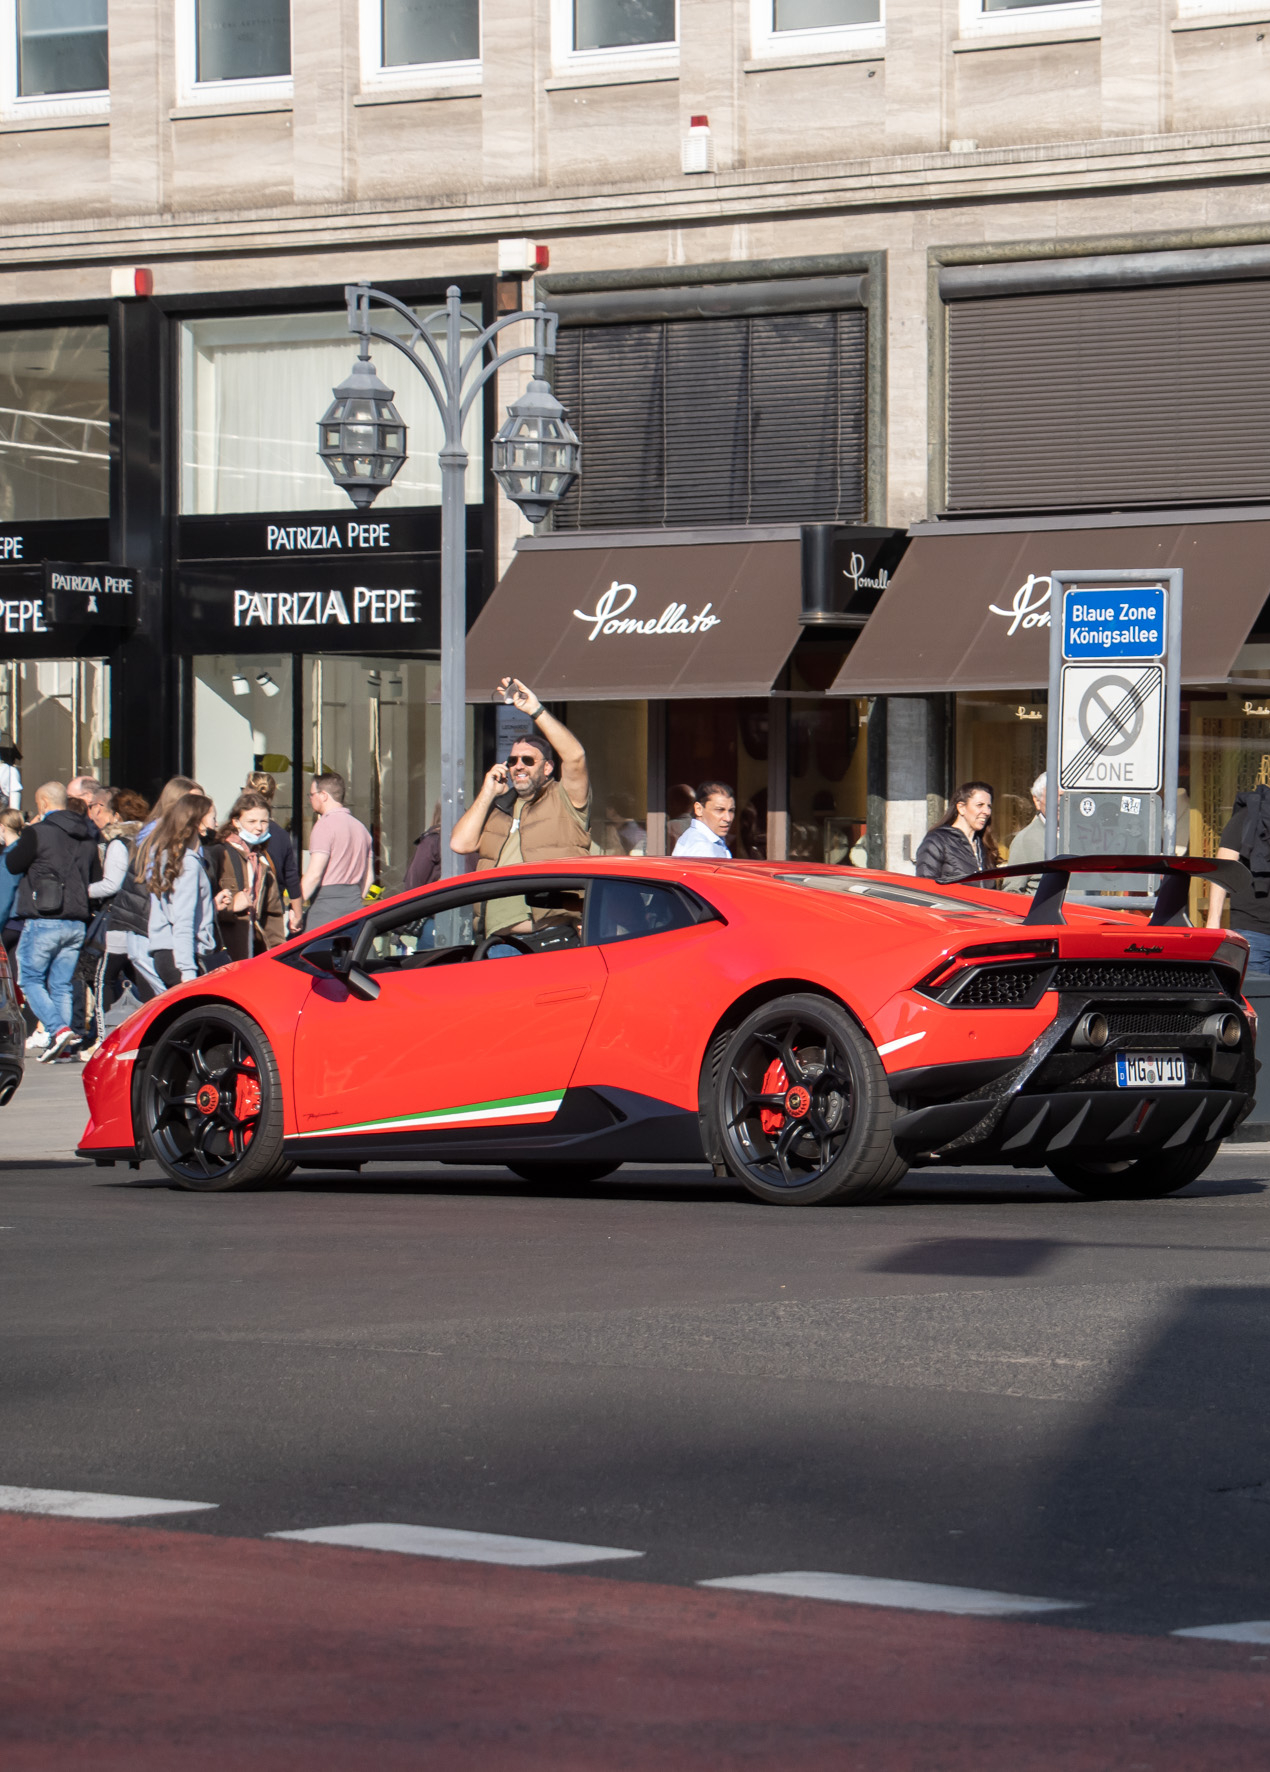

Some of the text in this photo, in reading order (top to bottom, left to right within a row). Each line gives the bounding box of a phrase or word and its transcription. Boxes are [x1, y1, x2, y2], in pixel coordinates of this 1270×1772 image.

[267, 522, 390, 550] PATRIZIA PEPE
[51, 572, 133, 595] PATRIZIA PEPE
[233, 586, 418, 627] PATRIZIA PEPE
[572, 580, 721, 641] Pomellato
[1072, 603, 1157, 622] Blaue Zone
[1069, 626, 1159, 648] Königsallee
[1085, 762, 1135, 782] ZONE
[1127, 1057, 1147, 1082] MG
